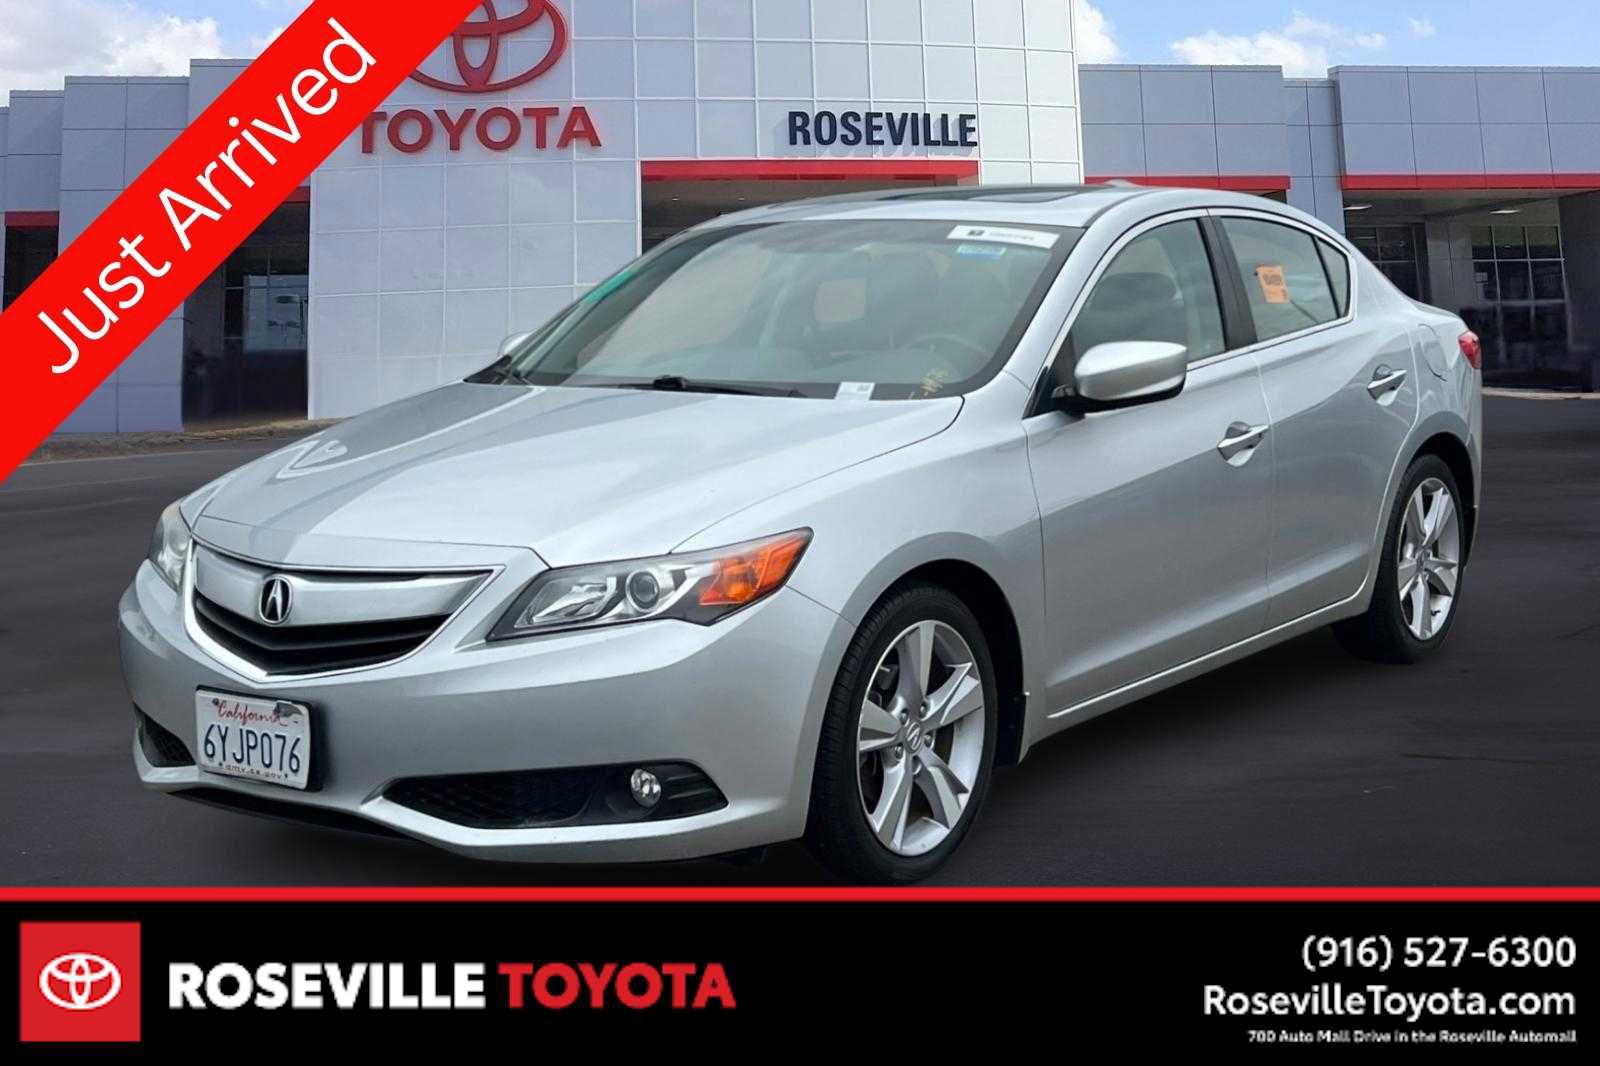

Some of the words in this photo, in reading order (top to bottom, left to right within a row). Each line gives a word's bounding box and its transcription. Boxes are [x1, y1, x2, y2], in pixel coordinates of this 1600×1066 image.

[361, 106, 602, 154] TOYOTA
[789, 111, 978, 147] ROSEVILLE
[216, 698, 285, 726] California
[204, 724, 301, 774] 6YJP076
